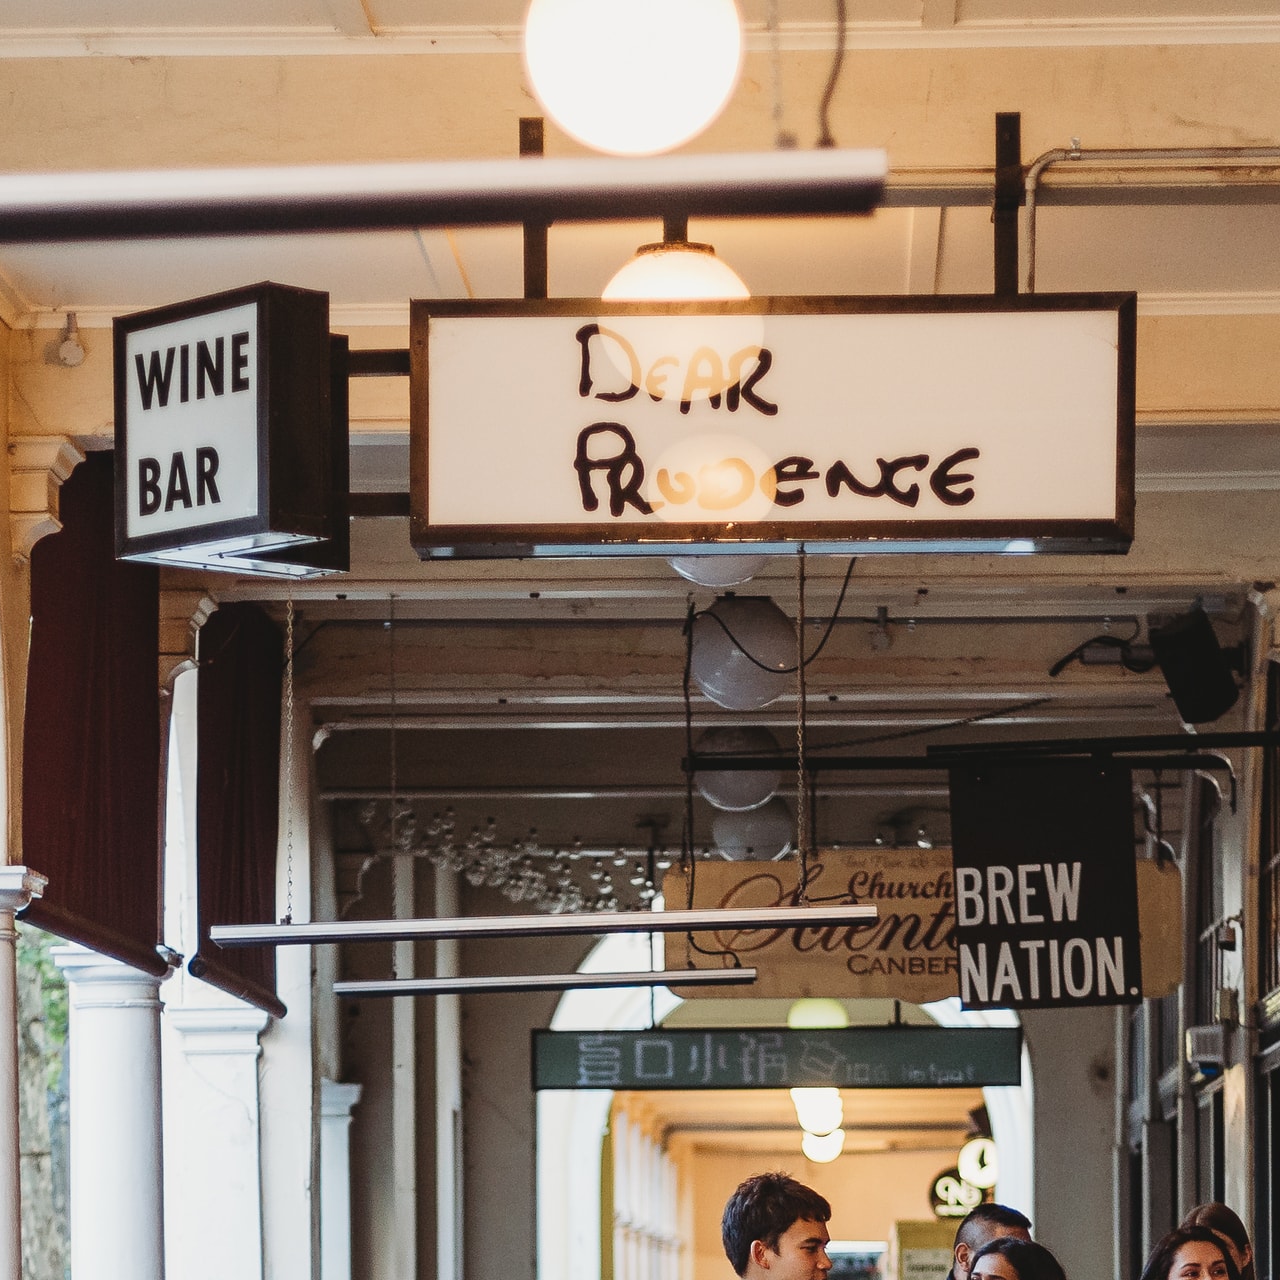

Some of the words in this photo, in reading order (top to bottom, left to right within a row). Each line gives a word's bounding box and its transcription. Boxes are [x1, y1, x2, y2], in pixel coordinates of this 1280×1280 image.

[134, 331, 250, 411] WINE
[138, 446, 222, 517] BAR
[847, 870, 953, 899] Church
[955, 861, 1082, 927] BREW
[959, 936, 1139, 1003] NATION.
